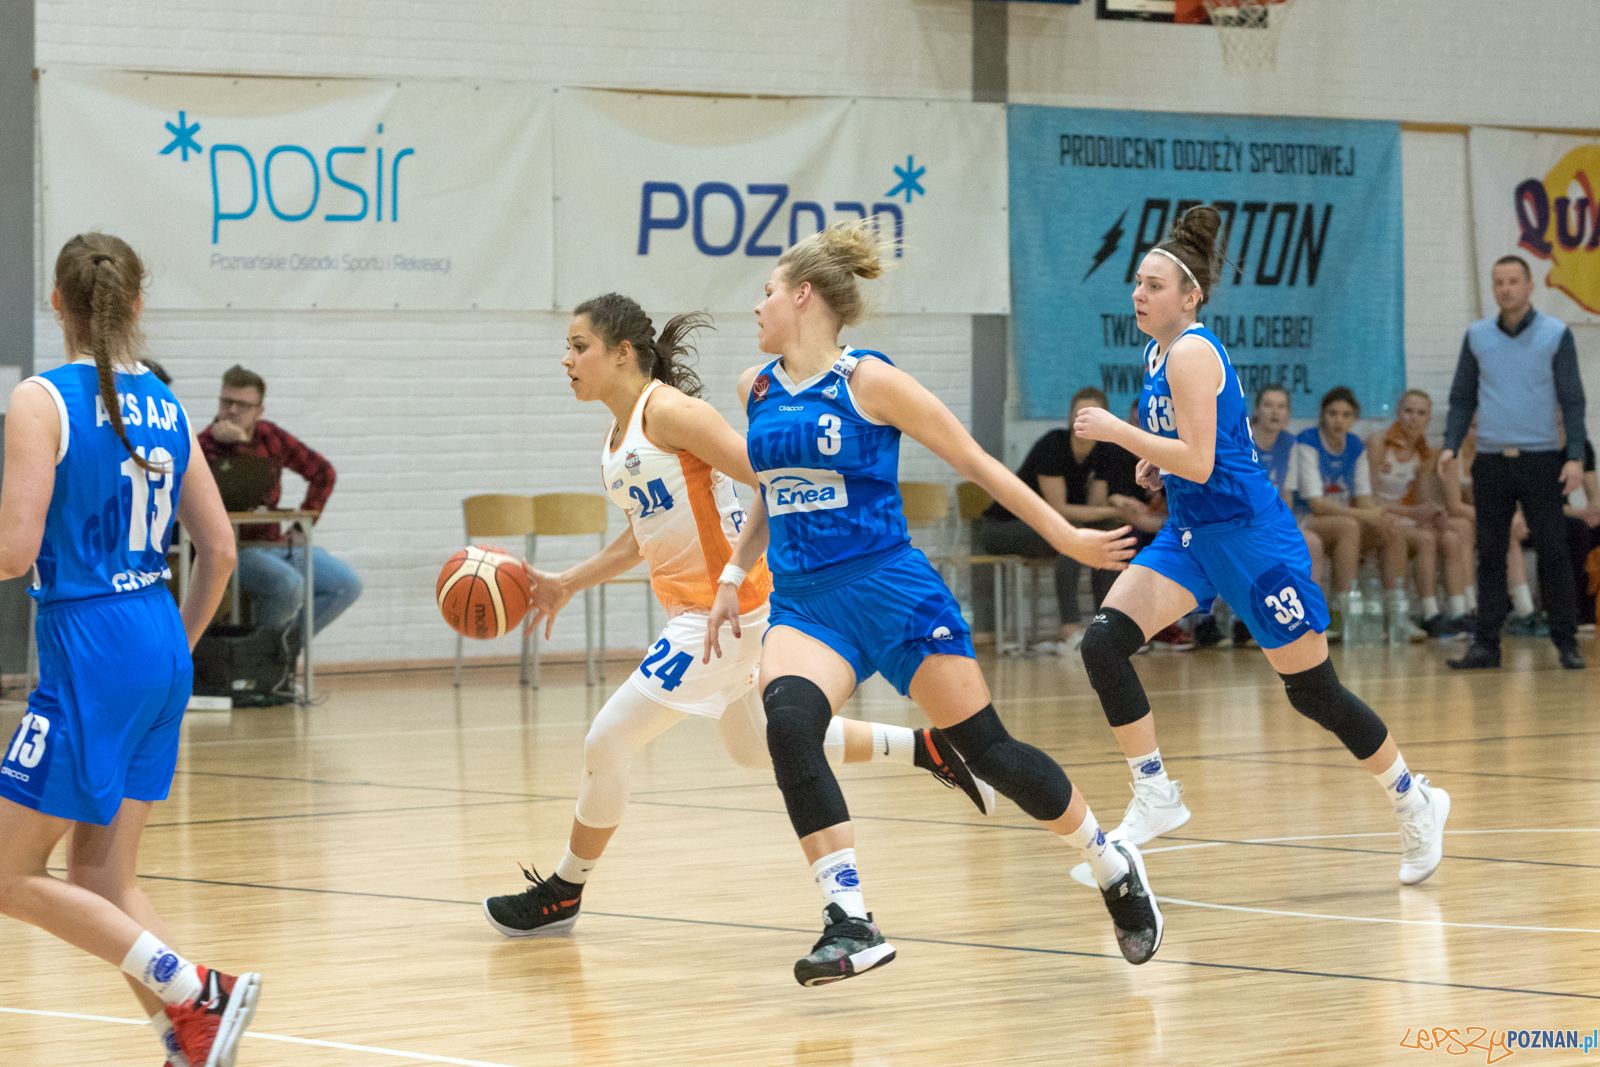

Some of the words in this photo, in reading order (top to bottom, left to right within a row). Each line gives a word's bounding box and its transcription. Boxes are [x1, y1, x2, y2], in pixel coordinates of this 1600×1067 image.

[1059, 134, 1166, 169] PRODUCENT
[1172, 134, 1243, 172] ODZIEŻY
[1249, 142, 1355, 176] SPORTOWEJ
[209, 122, 415, 244] posir
[1125, 198, 1332, 286] POTON
[1214, 313, 1247, 348] DLA
[817, 413, 842, 456] 3
[1146, 394, 1178, 433] 33
[121, 445, 174, 553] 13
[629, 477, 674, 518] 24
[777, 486, 836, 507] Enea
[1264, 586, 1305, 625] 33
[640, 638, 694, 692] 24
[8, 711, 51, 769] 13
